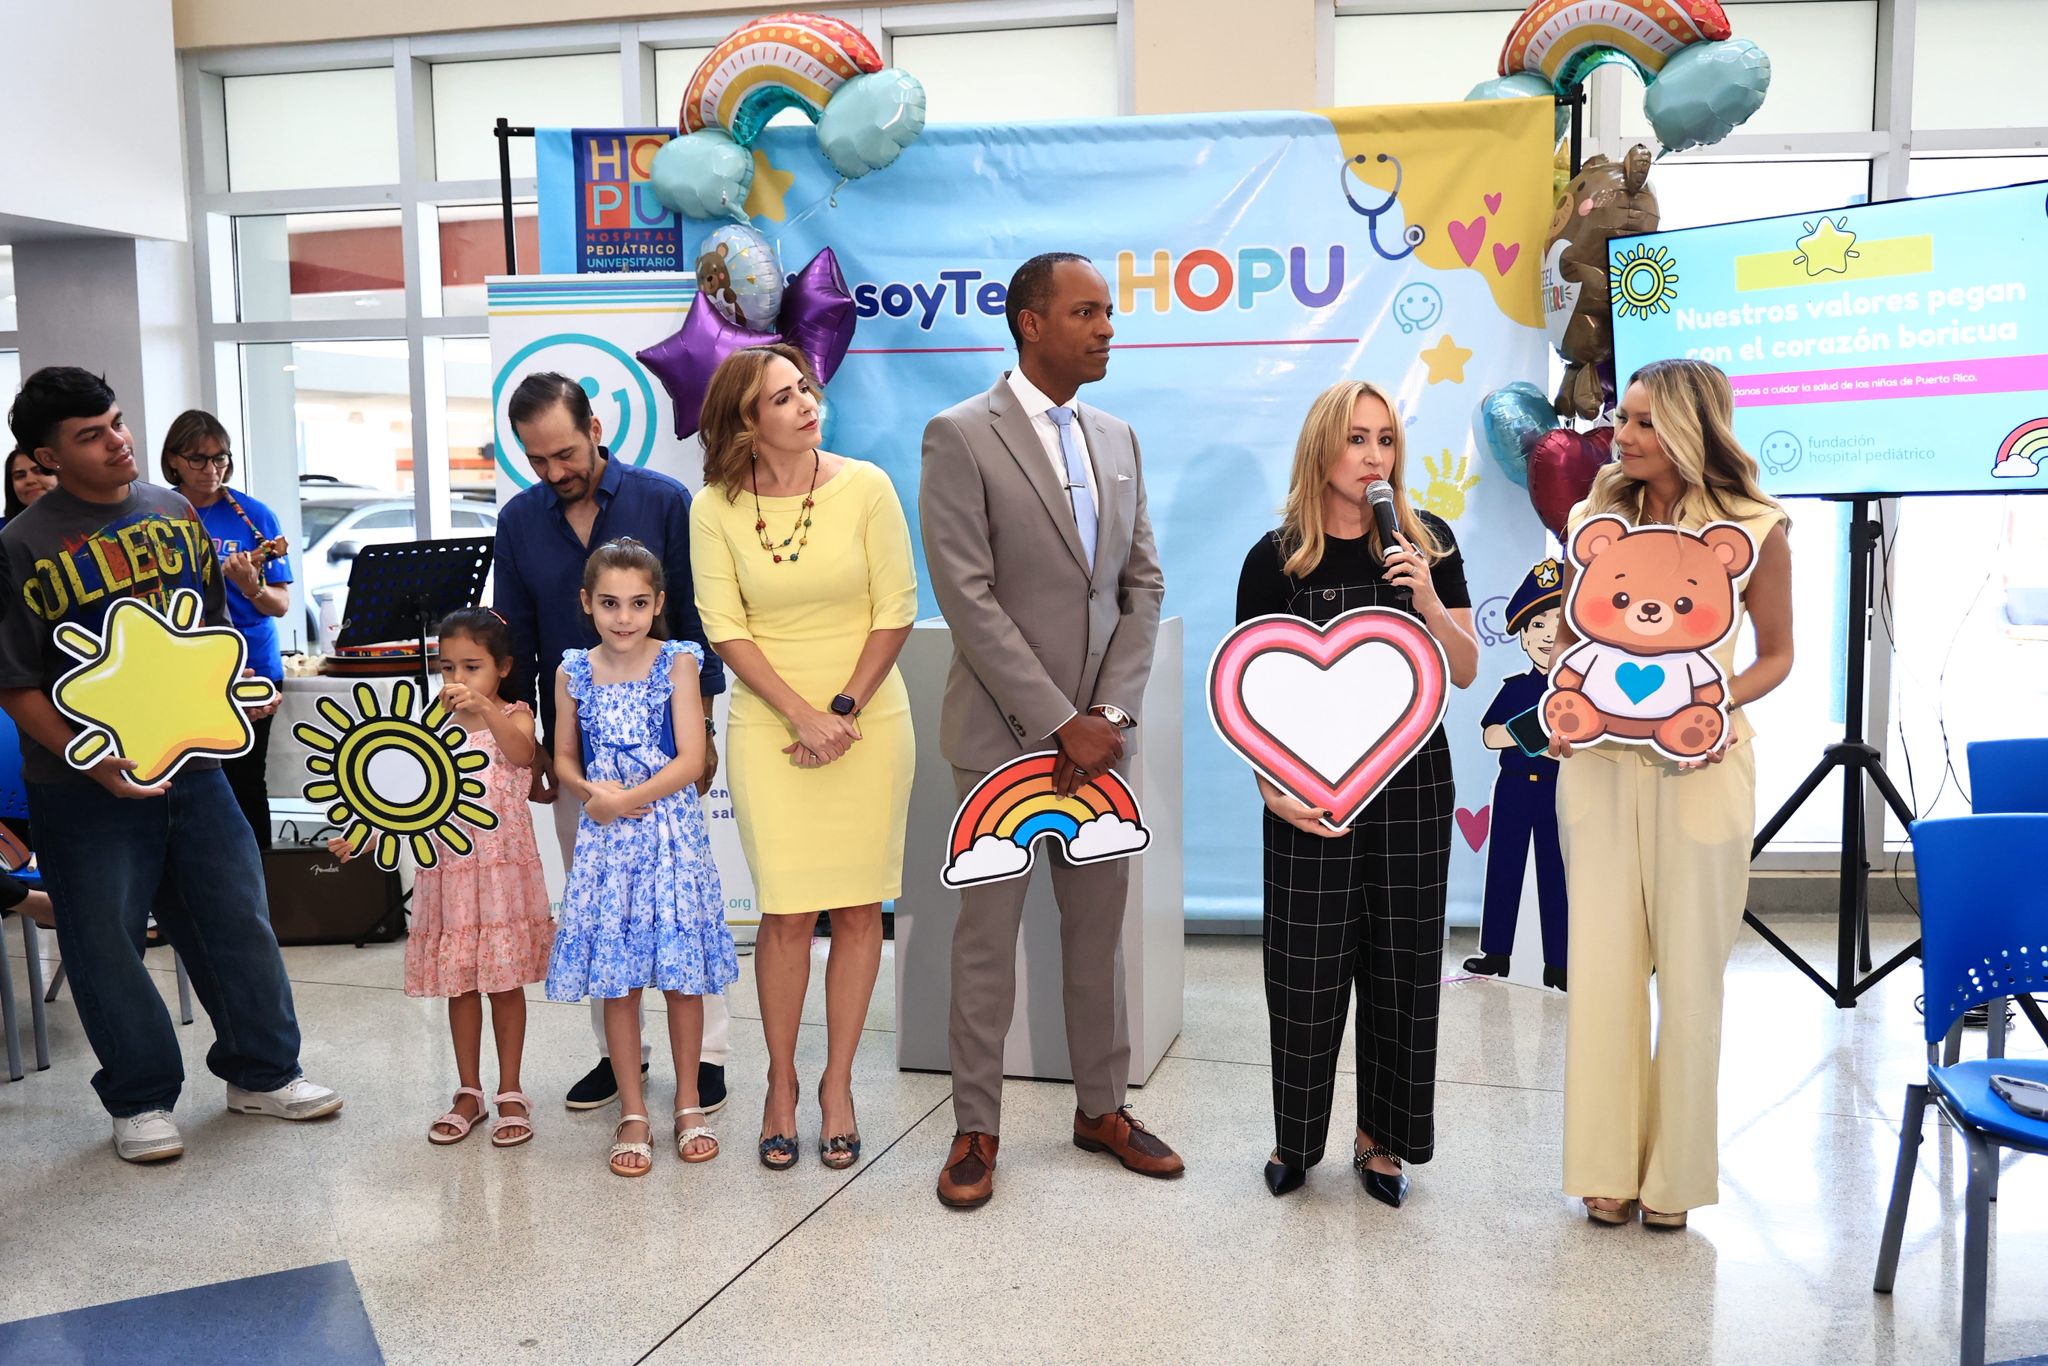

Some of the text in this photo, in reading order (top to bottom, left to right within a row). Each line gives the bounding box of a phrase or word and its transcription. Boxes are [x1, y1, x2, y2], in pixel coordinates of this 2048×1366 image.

[586, 232, 676, 242] HOSPITAL
[586, 242, 676, 255] PEDIÁTRICO
[586, 257, 676, 268] UNIVERSITARIO
[854, 245, 1345, 331] soyTe HOPU
[1676, 281, 2026, 333] Nuestros valores pegan
[1739, 335, 1765, 361] el
[1772, 327, 1890, 361] corazón
[1898, 319, 2019, 350] boricua
[1733, 372, 1978, 397] danos a cuidar la salud de los niños de Puerto Rico.
[1808, 434, 1876, 450] fundación
[1808, 446, 1935, 465] hospital pediátrico
[712, 807, 735, 819] sal
[310, 863, 339, 875] Fender
